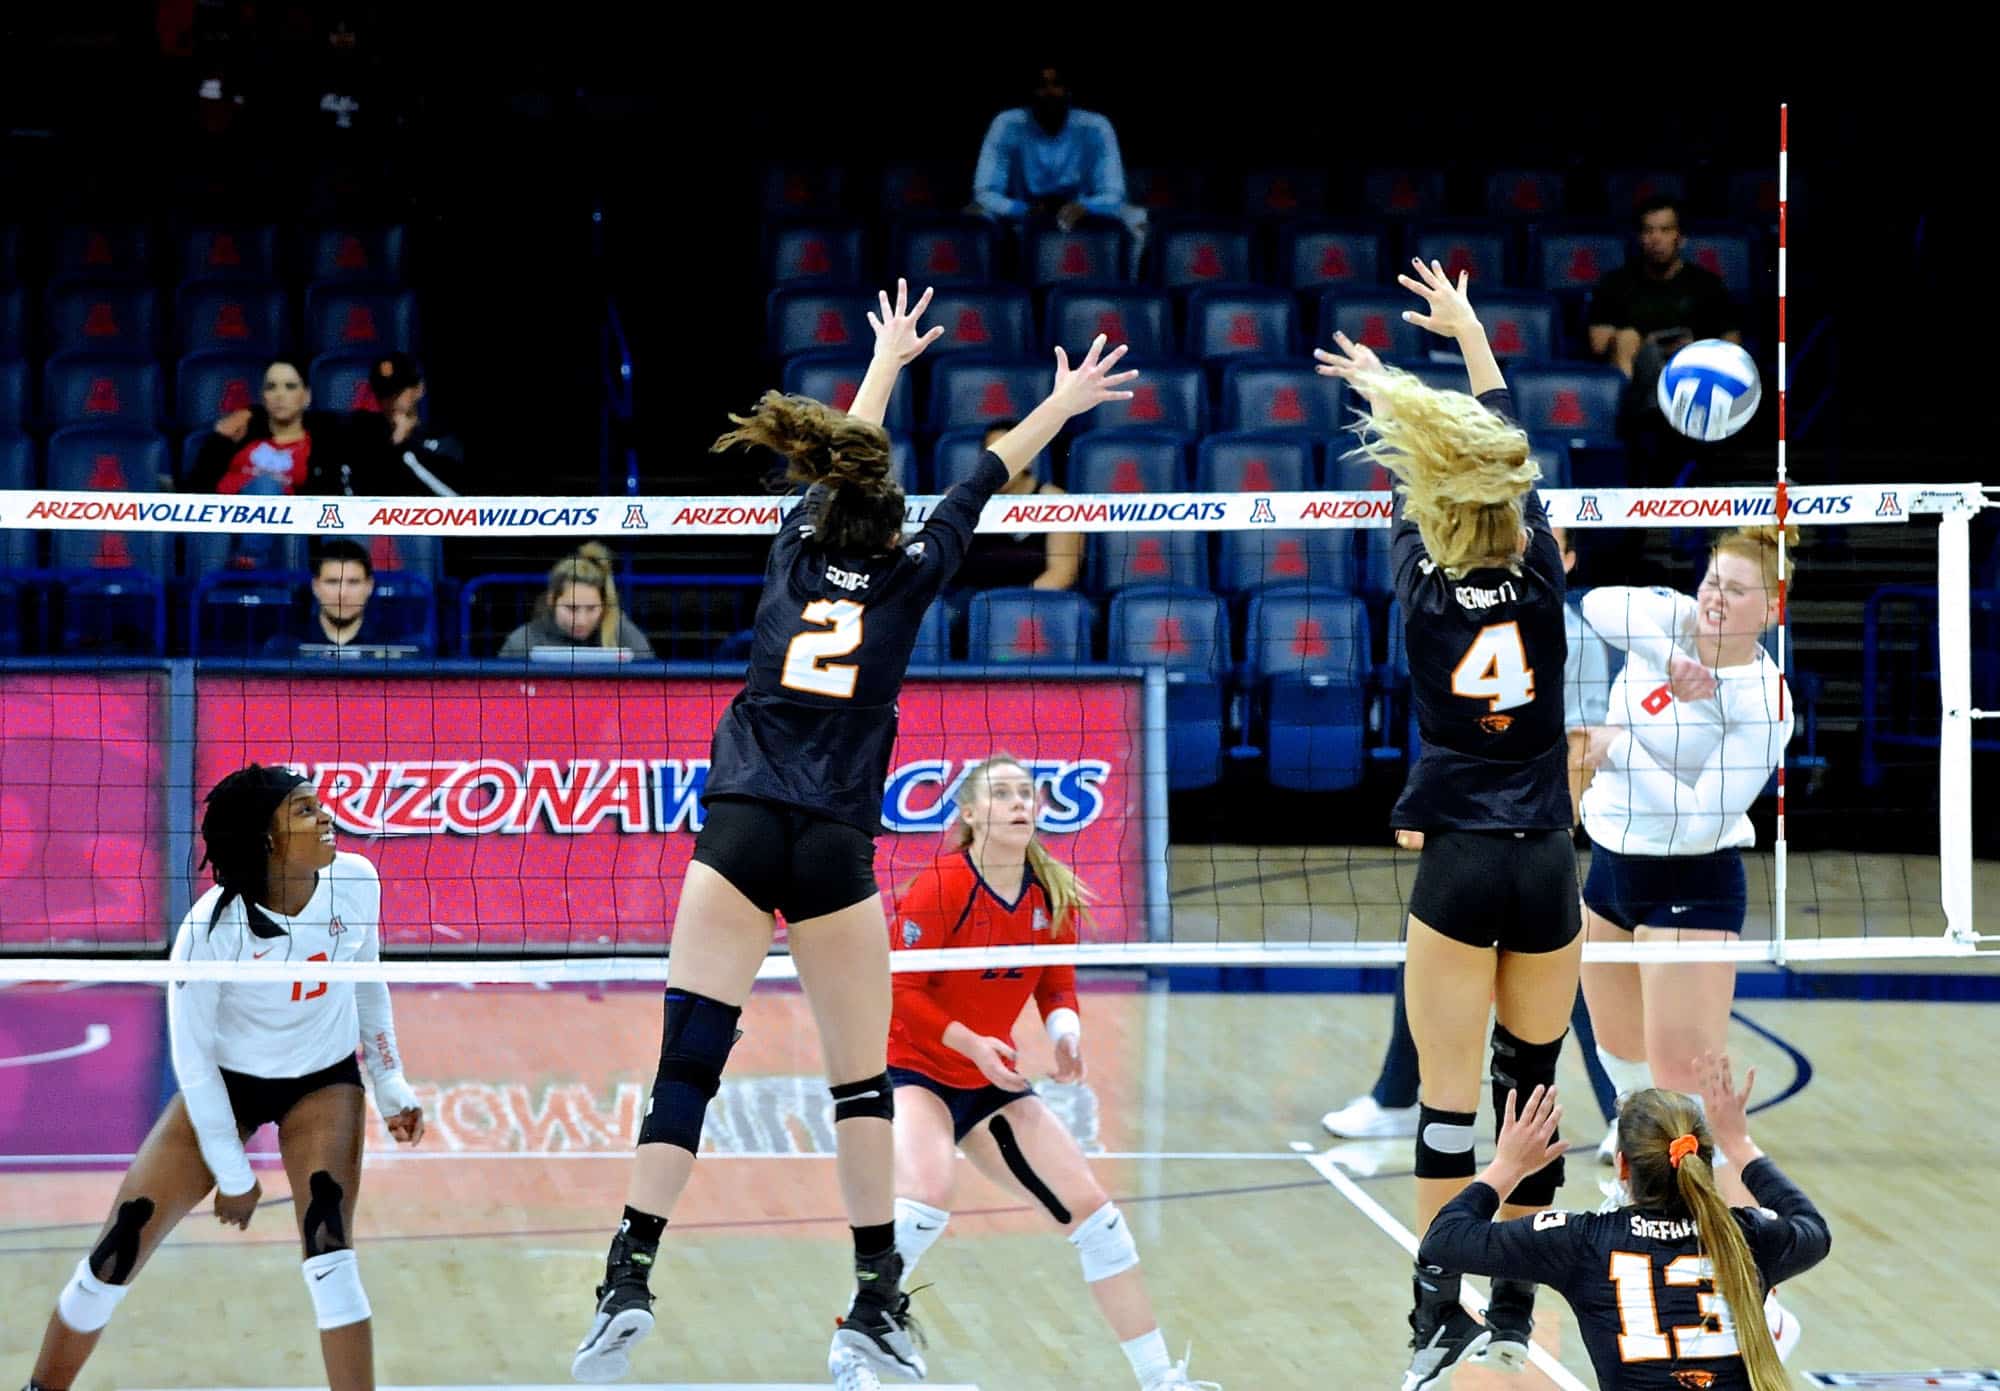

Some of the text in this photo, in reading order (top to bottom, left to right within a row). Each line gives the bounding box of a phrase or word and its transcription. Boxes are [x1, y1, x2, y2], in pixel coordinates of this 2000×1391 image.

[368, 507, 599, 526] ARIZONAWILDCATS
[1002, 502, 1227, 523] ARIZONAWILDCATS
[780, 598, 865, 699] 2
[1451, 620, 1537, 713] 4
[1608, 1250, 1742, 1364] 13
